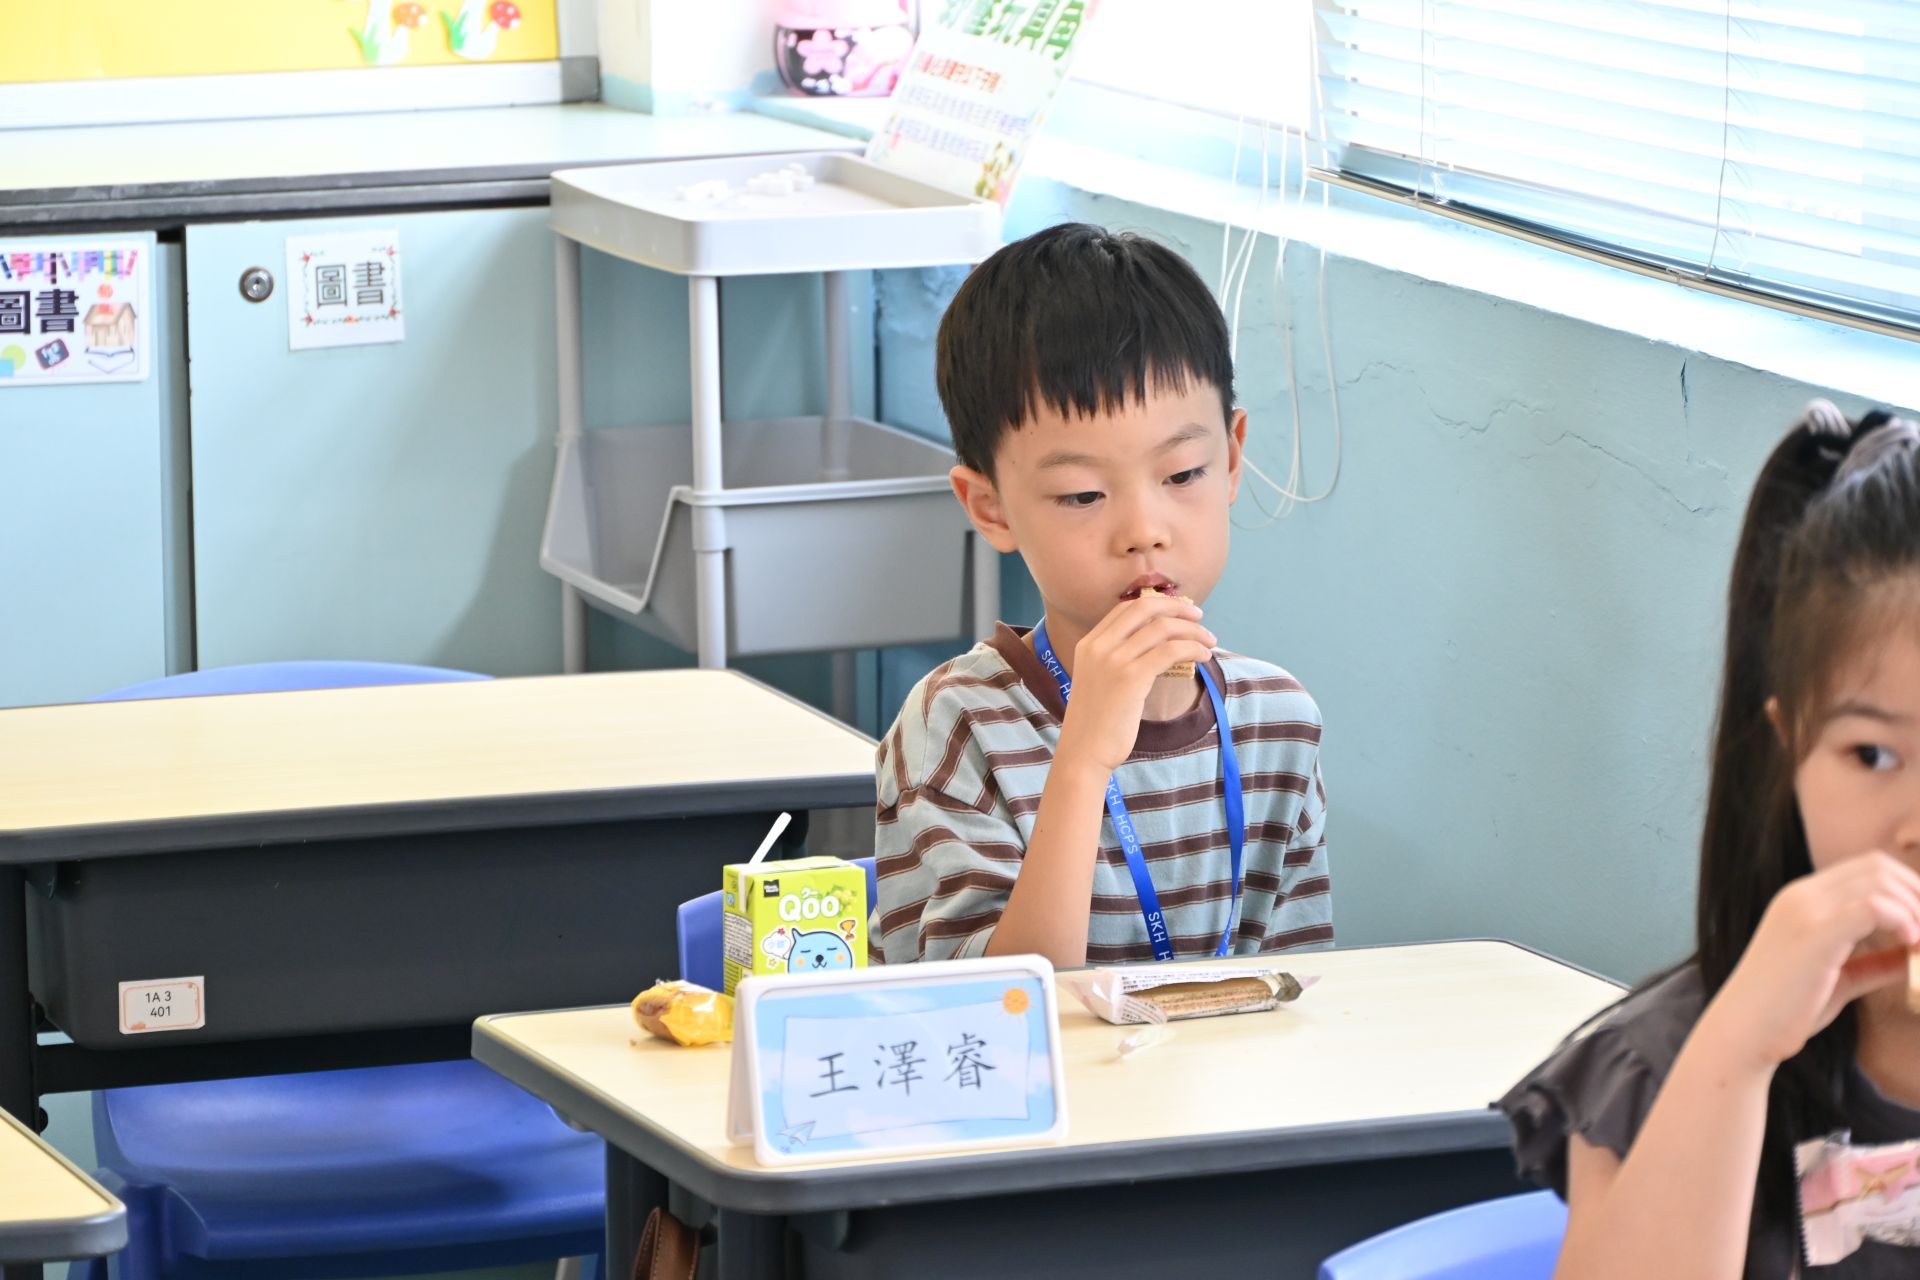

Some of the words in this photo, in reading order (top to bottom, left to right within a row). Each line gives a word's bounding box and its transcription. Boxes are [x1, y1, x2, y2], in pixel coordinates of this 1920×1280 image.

[315, 261, 386, 309] 圖書
[0, 288, 79, 335] 圖書
[1041, 649, 1062, 677] SKH
[1059, 682, 1071, 701] H
[1115, 814, 1138, 855] HCPS
[779, 893, 841, 923] Qoo
[1148, 911, 1167, 943] SKH
[145, 992, 160, 1003] 1A
[164, 990, 172, 1002] 3
[150, 1005, 171, 1017] 401
[809, 1032, 998, 1098] 王澤睿
